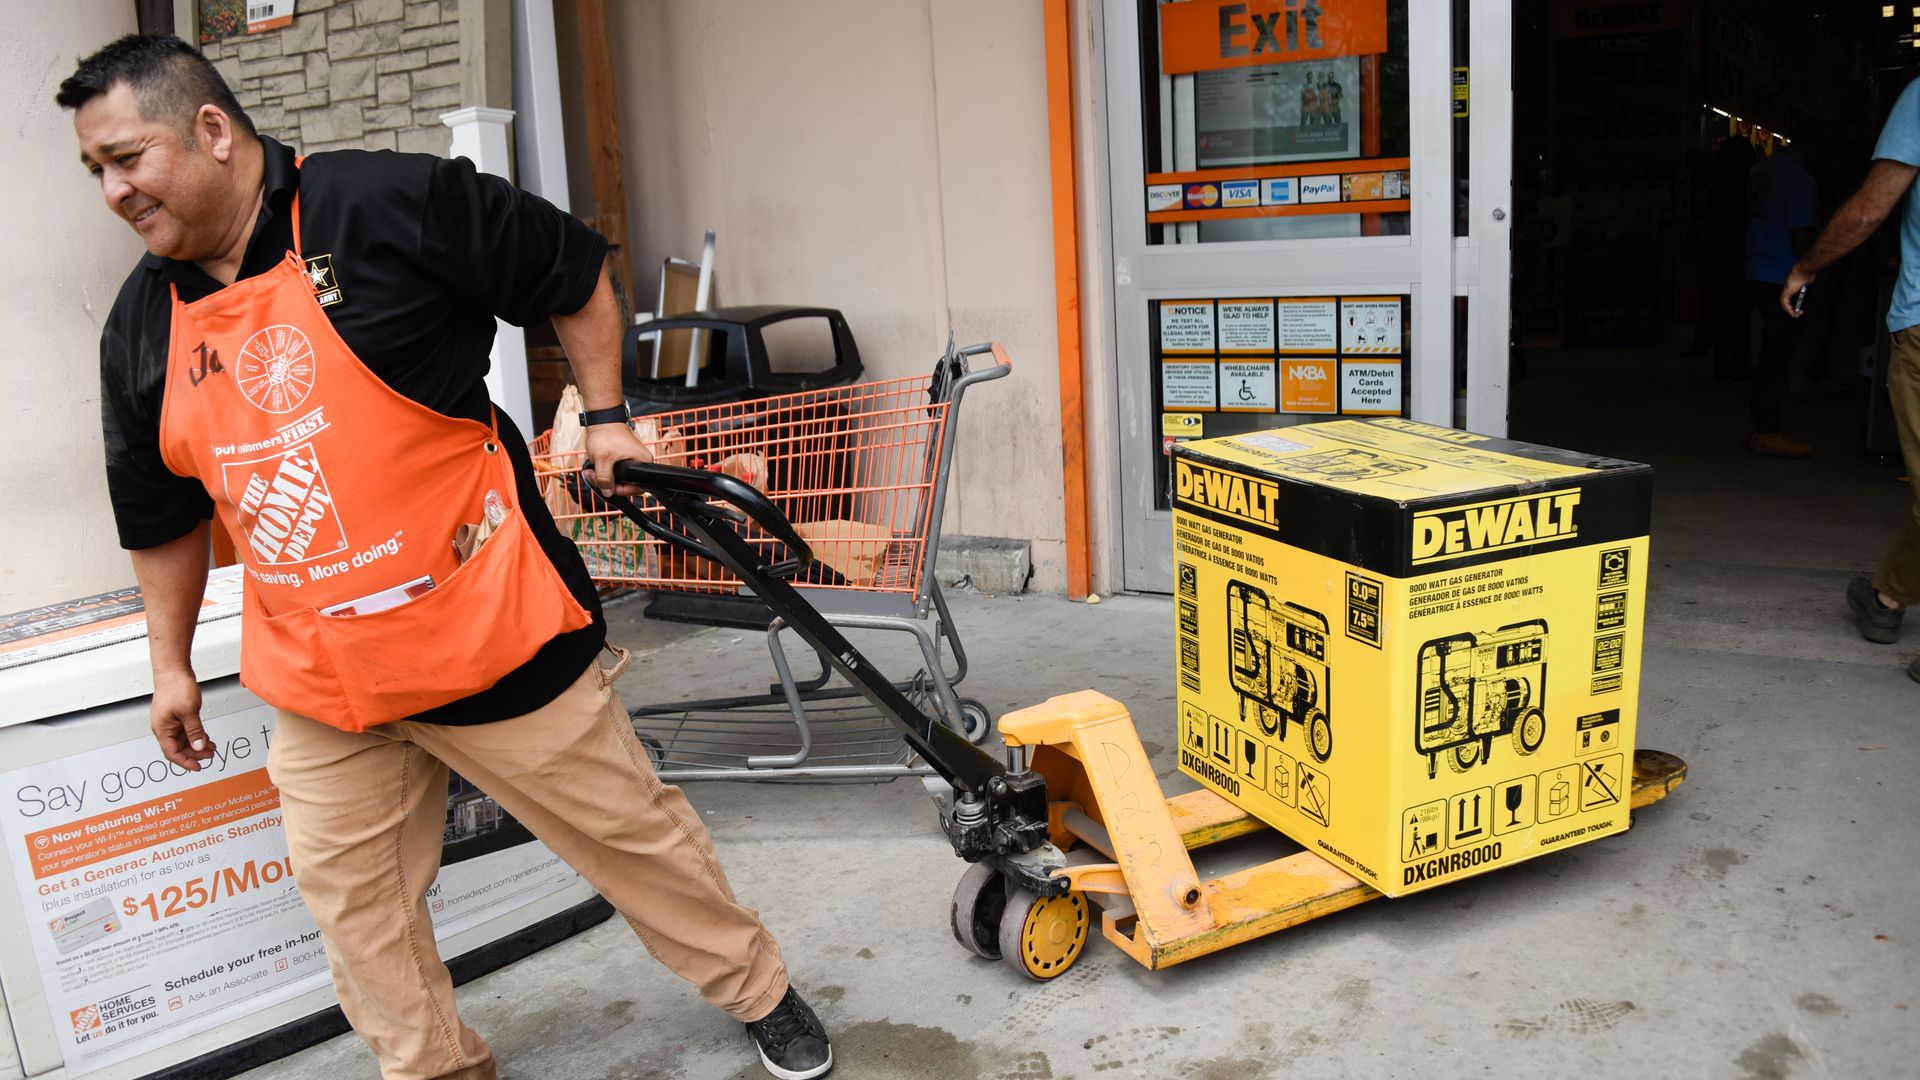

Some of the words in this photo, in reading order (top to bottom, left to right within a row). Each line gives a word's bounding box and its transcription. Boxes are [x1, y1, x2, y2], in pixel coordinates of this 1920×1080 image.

[1218, 0, 1323, 58] Exit
[1150, 190, 1181, 199] DISCOVER
[1229, 188, 1252, 199] VISA
[1302, 184, 1335, 196] PayPal
[319, 292, 339, 305] ARMY
[1174, 306, 1207, 316] NOTICE
[1244, 305, 1270, 313] ALWAYS
[1289, 365, 1328, 381] NKBA
[1348, 369, 1394, 378] ATM/Debit
[1358, 378, 1384, 386] Cards
[1350, 387, 1392, 397] Accepted
[1361, 396, 1382, 404] Here
[214, 444, 235, 458] put
[280, 411, 326, 445] FIRST
[238, 472, 270, 517] THE
[250, 450, 319, 563] HOME
[284, 485, 332, 561] DEPOT
[1176, 516, 1187, 526] 8000
[1188, 518, 1201, 530] WATT
[1201, 523, 1212, 534] GAS
[1212, 526, 1243, 546] GENERATOR
[1176, 529, 1204, 546] GENERADOR
[1204, 537, 1211, 547] DE
[1212, 540, 1222, 551] GAS
[1222, 544, 1230, 554] DE
[1231, 547, 1245, 559] 8000
[1245, 551, 1265, 567] VATIOS
[259, 570, 304, 588] saving.
[308, 555, 349, 581] More
[1212, 555, 1236, 572] ESSENCE
[1236, 563, 1244, 574] DE
[1244, 567, 1259, 579] 8000
[1259, 572, 1278, 586] WATTS
[1409, 582, 1428, 594] 8000
[1428, 578, 1448, 590] WATT
[1449, 575, 1463, 586] GAS
[1464, 568, 1503, 583] GENERATOR
[1352, 581, 1369, 601] 9.0
[1409, 591, 1451, 607] GENERADOR
[1451, 589, 1461, 600] DE
[1461, 586, 1476, 597] GAS
[1477, 583, 1487, 594] DE
[1487, 580, 1505, 592] 8000
[1505, 575, 1529, 589] VATIOS
[1462, 594, 1492, 609] ESSENCE
[1493, 592, 1502, 603] DE
[1503, 589, 1521, 601] 8000
[1521, 585, 1544, 598] WATTS
[1352, 609, 1368, 629] 7.5
[1182, 749, 1240, 798] DXGNR8000
[1279, 755, 1284, 764] 6
[1556, 770, 1563, 781] 6
[17, 780, 87, 817] Say
[37, 845, 75, 861] Connect
[75, 840, 94, 852] your
[126, 820, 158, 836] enabled
[159, 810, 196, 828] generator
[197, 803, 214, 815] with
[214, 802, 228, 811] our
[228, 794, 253, 806] Mobile
[39, 862, 59, 875] your
[61, 847, 107, 867] generator's
[107, 840, 133, 854] status
[133, 837, 142, 846] in
[201, 815, 213, 825] for
[213, 805, 251, 821] enhanced
[51, 829, 82, 844] Now
[84, 812, 142, 835] featuring
[1540, 827, 1586, 846] GUARANTEED
[38, 879, 68, 896] Get
[70, 877, 81, 887] a
[84, 857, 148, 883] Generac
[151, 834, 225, 864] Automatic
[227, 815, 283, 840] Standby
[1317, 839, 1355, 866] GUARANTEED
[1403, 842, 1502, 886] DXGNR8000
[41, 895, 72, 913] (plus
[74, 874, 138, 902] installation)
[141, 869, 156, 881] for
[159, 864, 173, 876] as
[174, 857, 195, 872] low
[197, 853, 212, 865] as
[164, 964, 225, 992] Schedule
[227, 953, 256, 973] your
[258, 943, 283, 959] free
[188, 992, 207, 1005] Ask
[208, 985, 222, 998] an
[223, 967, 269, 991] Associate
[99, 995, 133, 1012] HOME
[101, 996, 156, 1021] SERVICES
[75, 1033, 91, 1045] Let
[92, 1030, 104, 1040] us
[105, 1025, 117, 1036] do
[118, 1020, 126, 1031] it
[126, 1016, 139, 1027] for
[140, 1010, 160, 1024] you.
